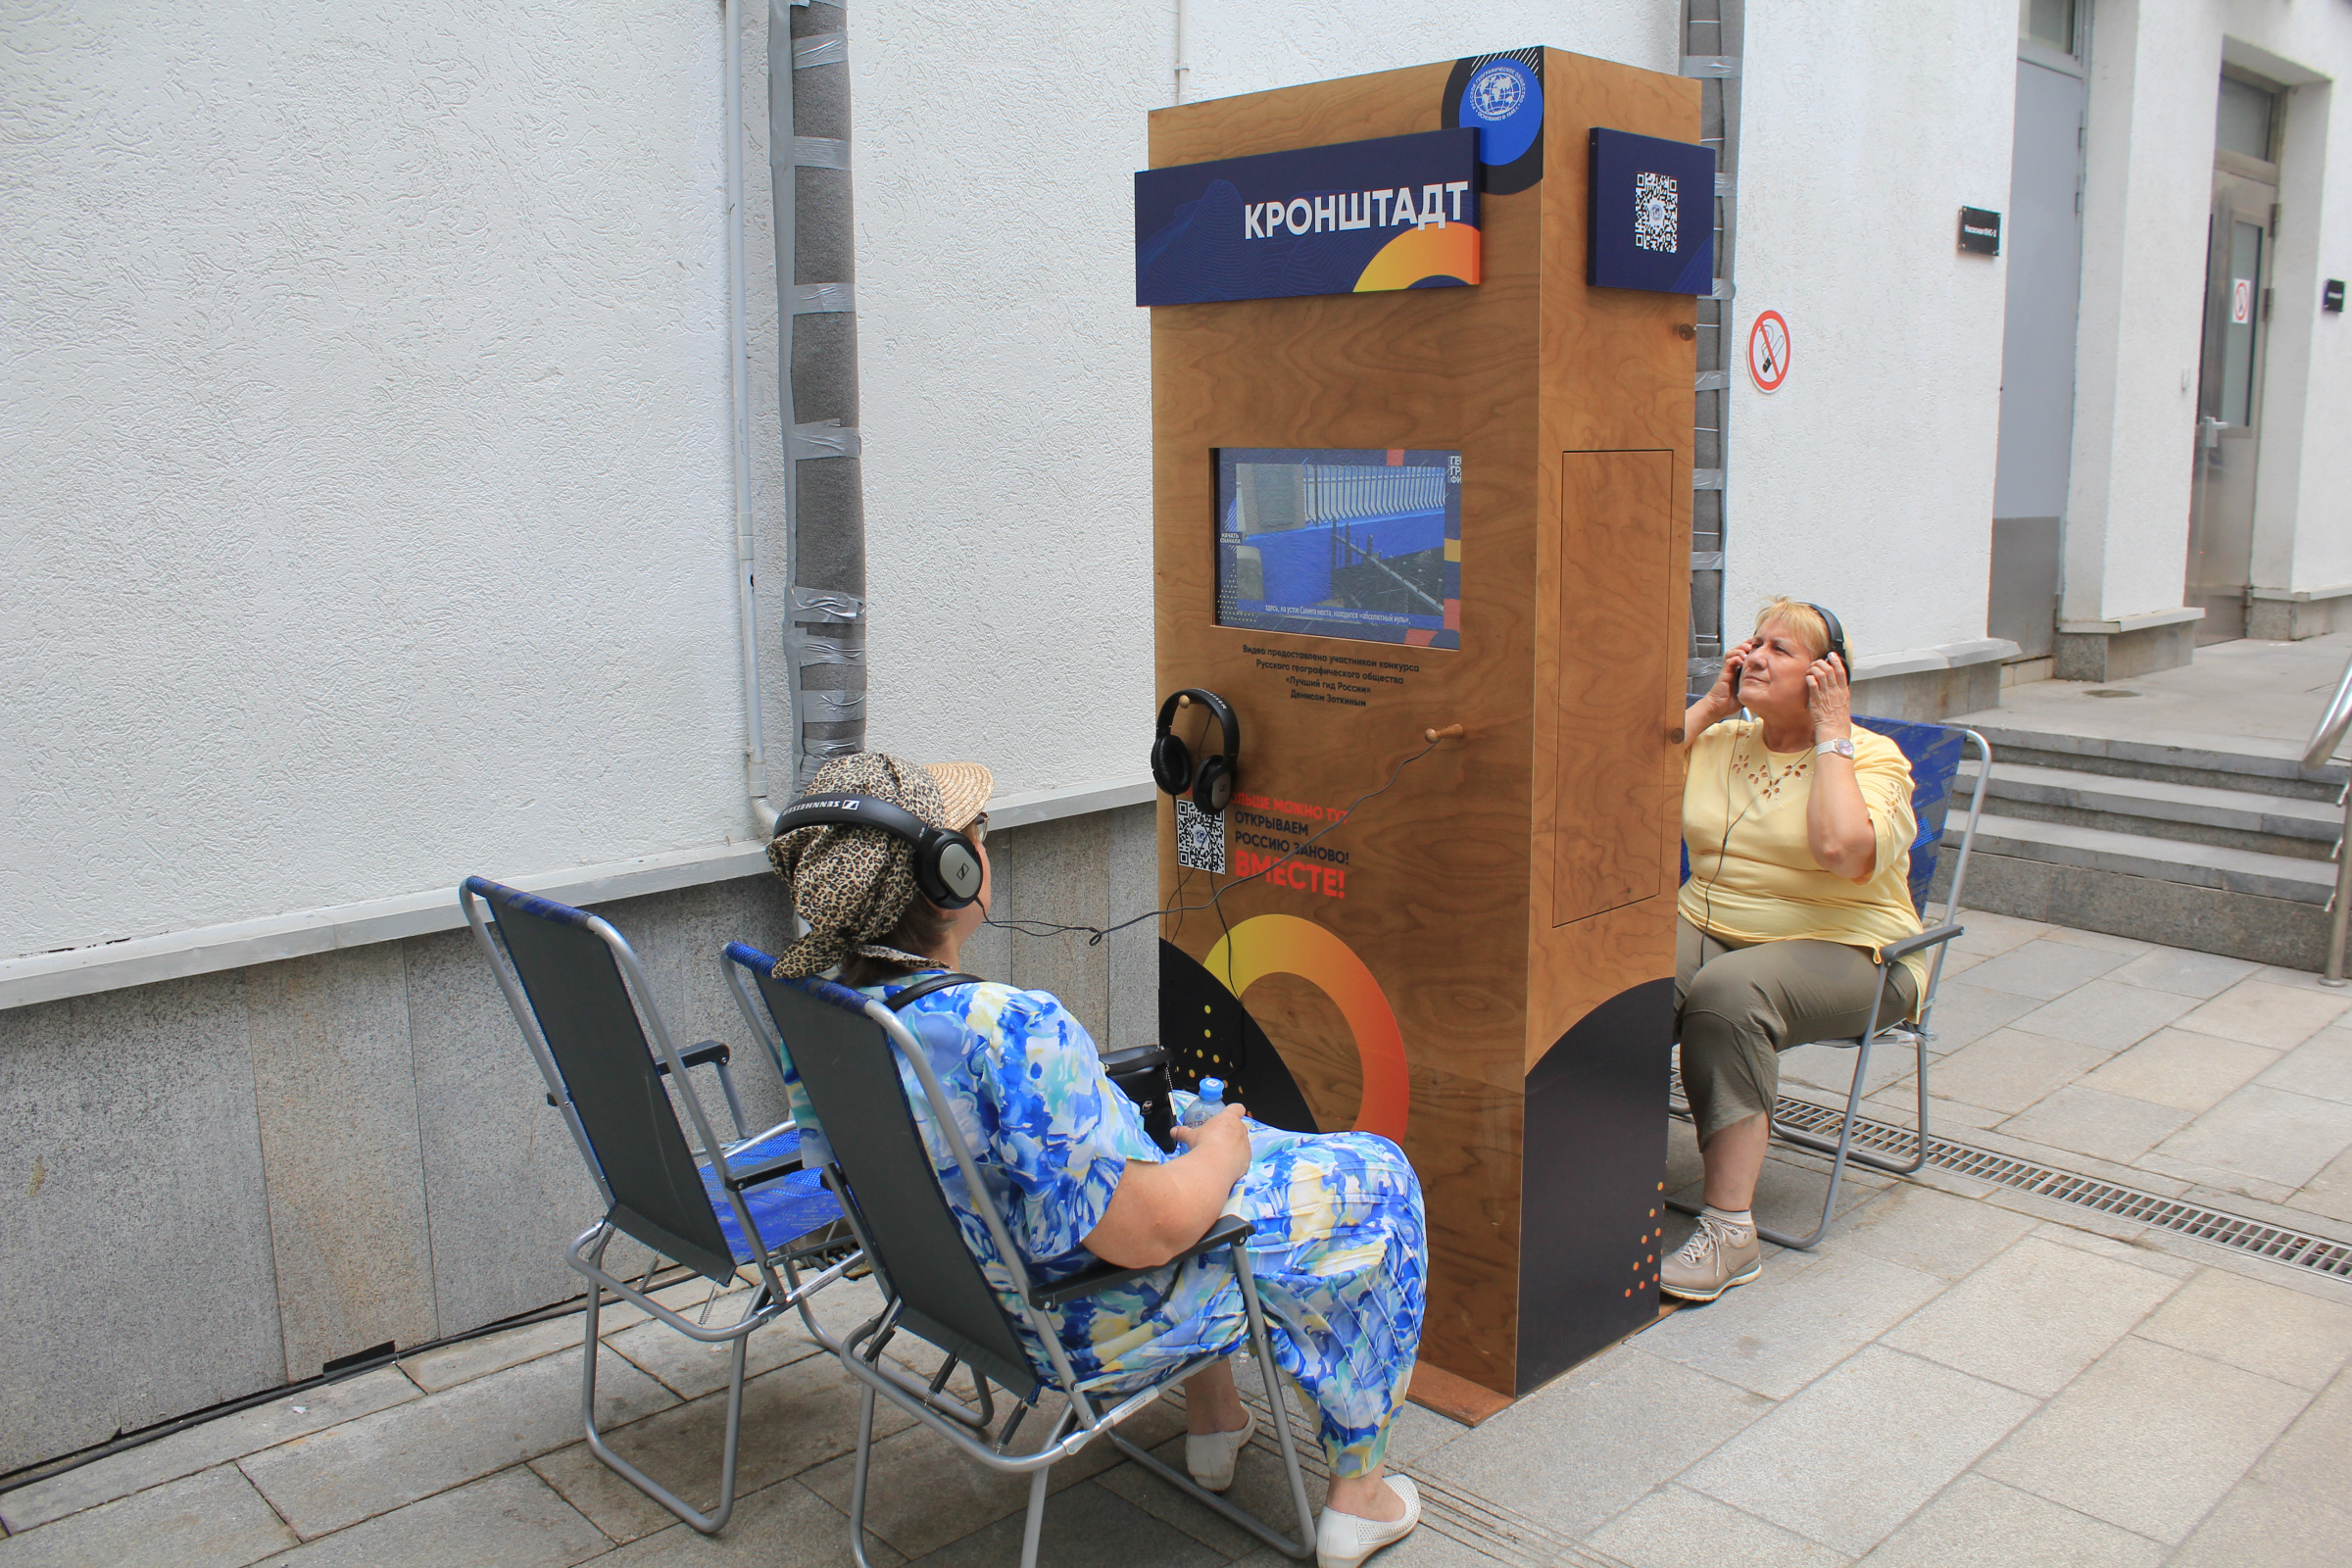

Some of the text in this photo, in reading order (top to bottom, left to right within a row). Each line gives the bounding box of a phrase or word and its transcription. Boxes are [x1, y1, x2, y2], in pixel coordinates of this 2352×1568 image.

[1244, 180, 1469, 240] КРОНШТАДТ
[1242, 644, 1420, 672] Видео предоставлено участником конкурса
[1255, 659, 1404, 684] Русского географического общества
[1286, 675, 1371, 694] «Лучший гид России»
[1290, 689, 1367, 707] Денисом Зоткиным
[1230, 792, 1348, 824] ОЛЬШЕ МОЖНО ТУТ
[1235, 811, 1309, 836] ОТКРЫВАЕМ
[1235, 830, 1291, 853] РОССИЮ
[1235, 849, 1346, 899] ВМЕСТЕ!
